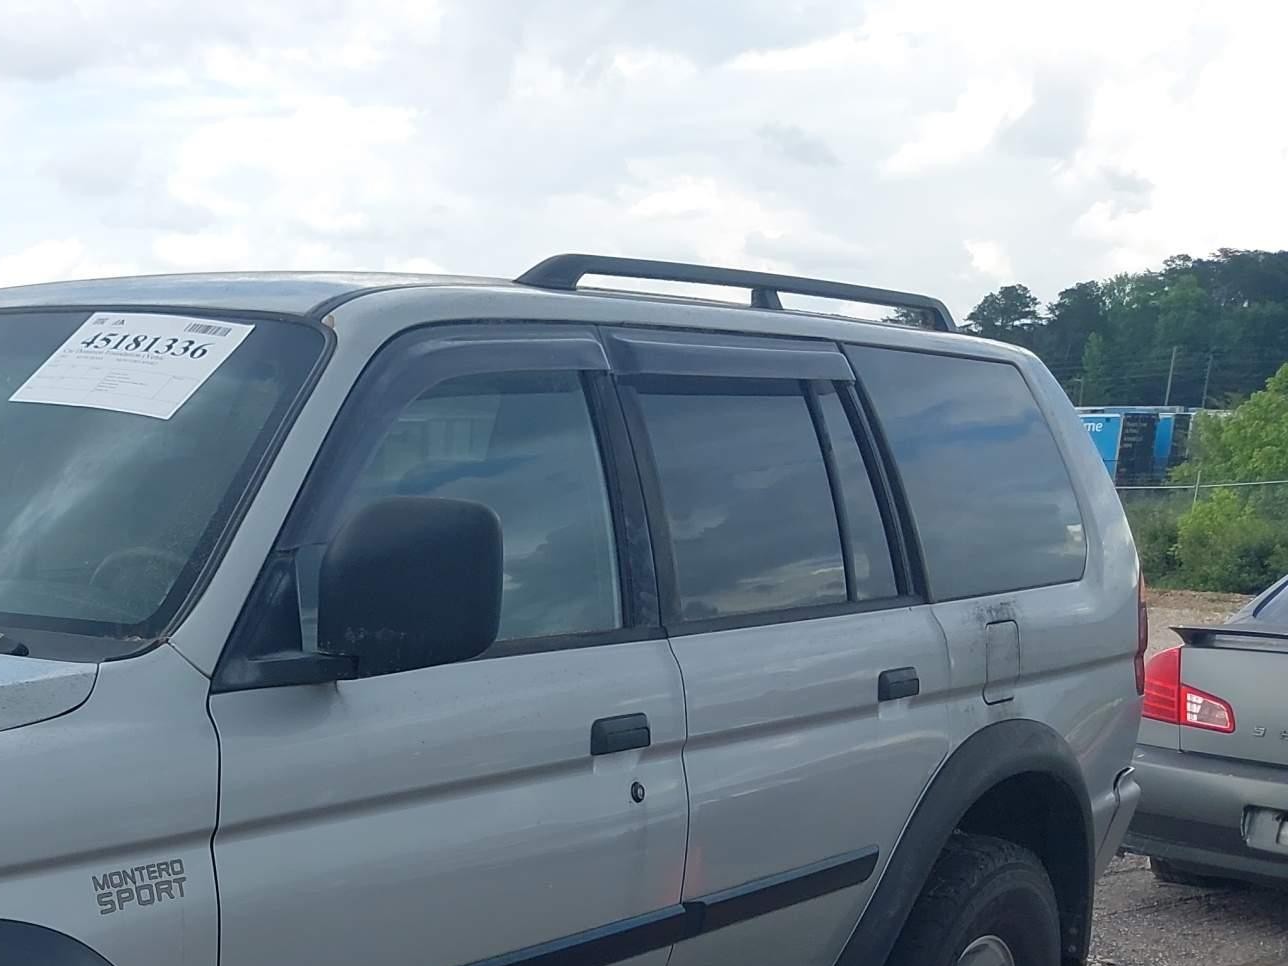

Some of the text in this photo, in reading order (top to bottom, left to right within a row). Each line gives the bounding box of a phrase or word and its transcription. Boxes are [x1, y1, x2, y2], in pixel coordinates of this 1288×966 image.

[80, 331, 216, 361] 45181336
[92, 858, 185, 891] MONTERO
[97, 877, 187, 915] SPORT
